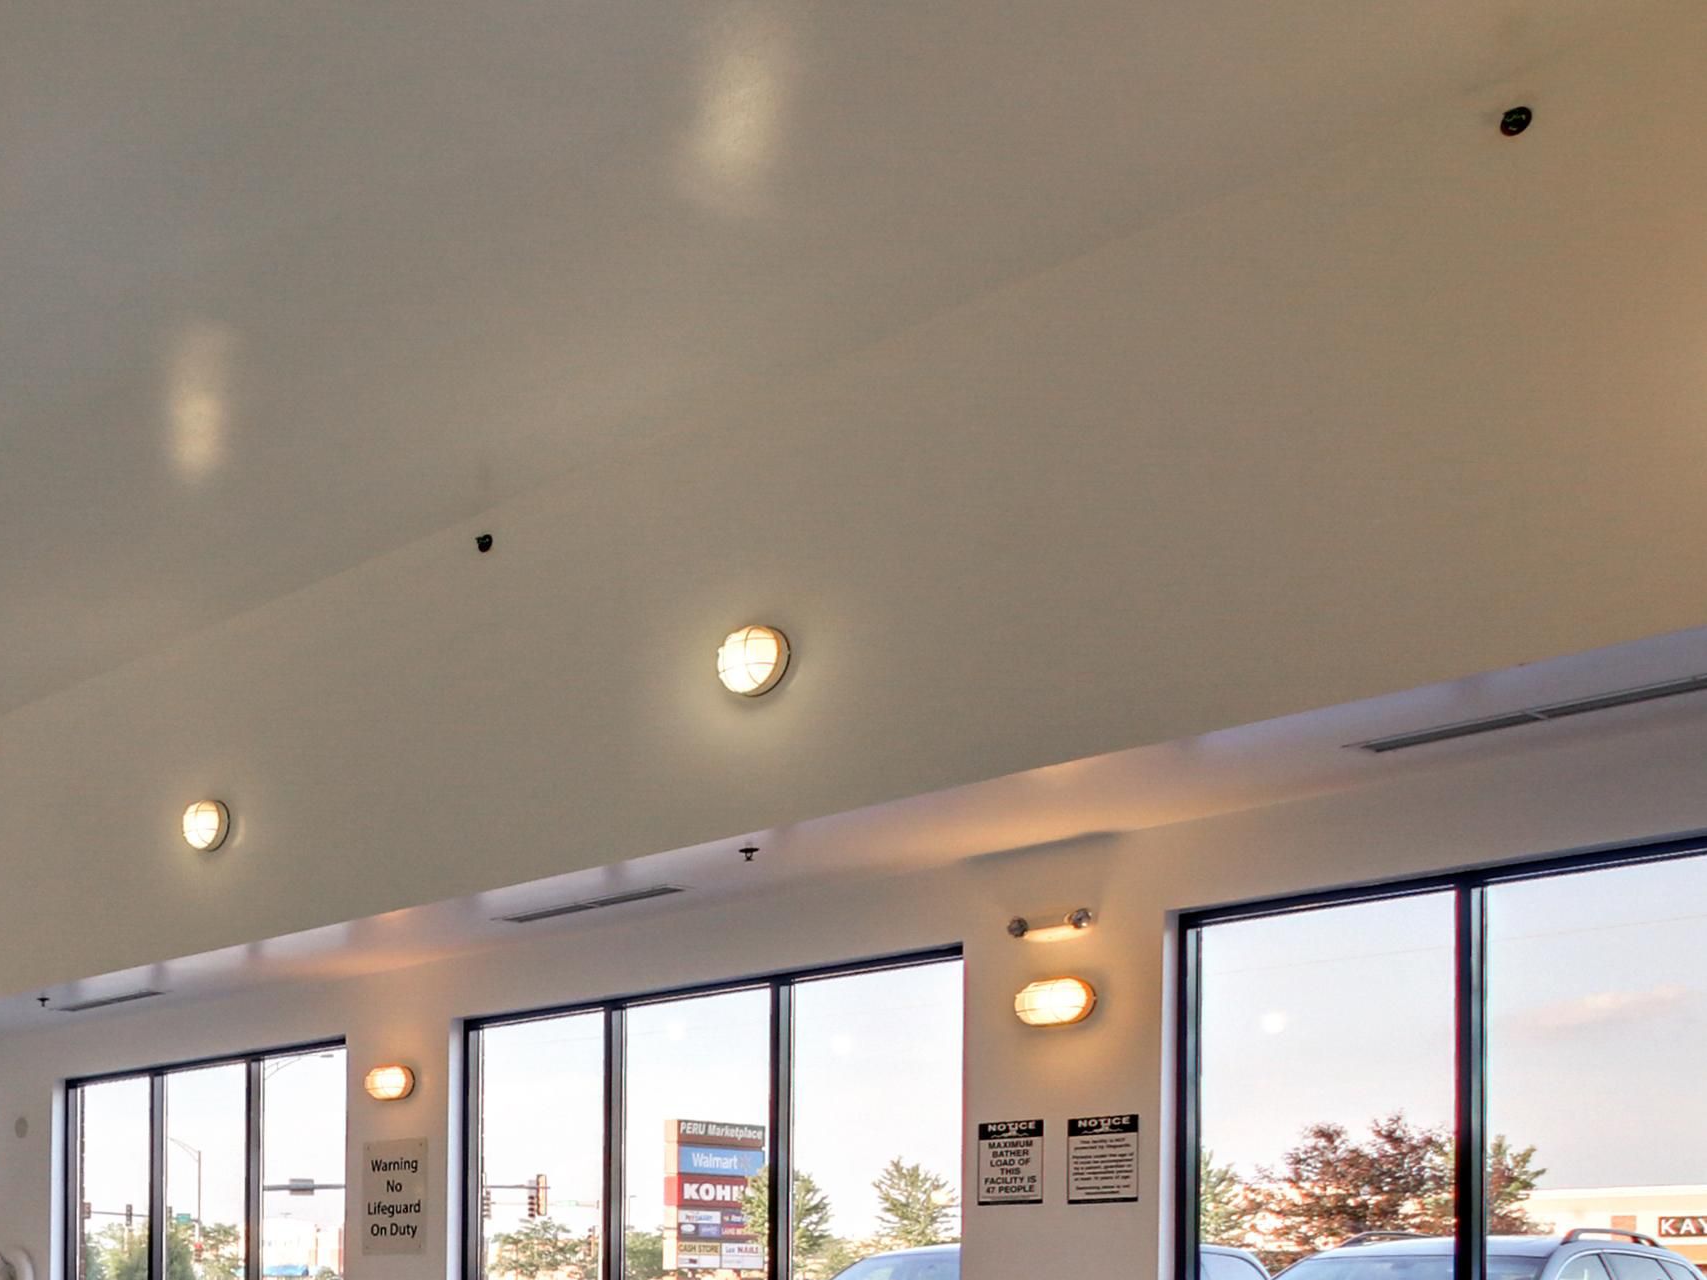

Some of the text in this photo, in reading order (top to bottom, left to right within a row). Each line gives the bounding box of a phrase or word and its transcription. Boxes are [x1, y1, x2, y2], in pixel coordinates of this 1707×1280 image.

[987, 1121, 1036, 1132] NOTICE
[1077, 1116, 1131, 1128] NOTICE
[680, 1122, 763, 1141] PERU Marketplace
[988, 1140, 1033, 1149] MAXIMUM
[992, 1149, 1029, 1158] BATHER
[371, 1157, 418, 1173] Warning
[692, 1152, 738, 1170] Walmart
[990, 1157, 1031, 1167] LOAD OF
[1000, 1167, 1021, 1175] THIS
[386, 1179, 403, 1192] No
[984, 1175, 1037, 1185] FACILITY IS
[998, 1185, 1035, 1193] PEOPLE
[367, 1199, 421, 1218] Lifeguard
[371, 1223, 418, 1238] On Duty
[678, 1243, 719, 1254] CASH STORE
